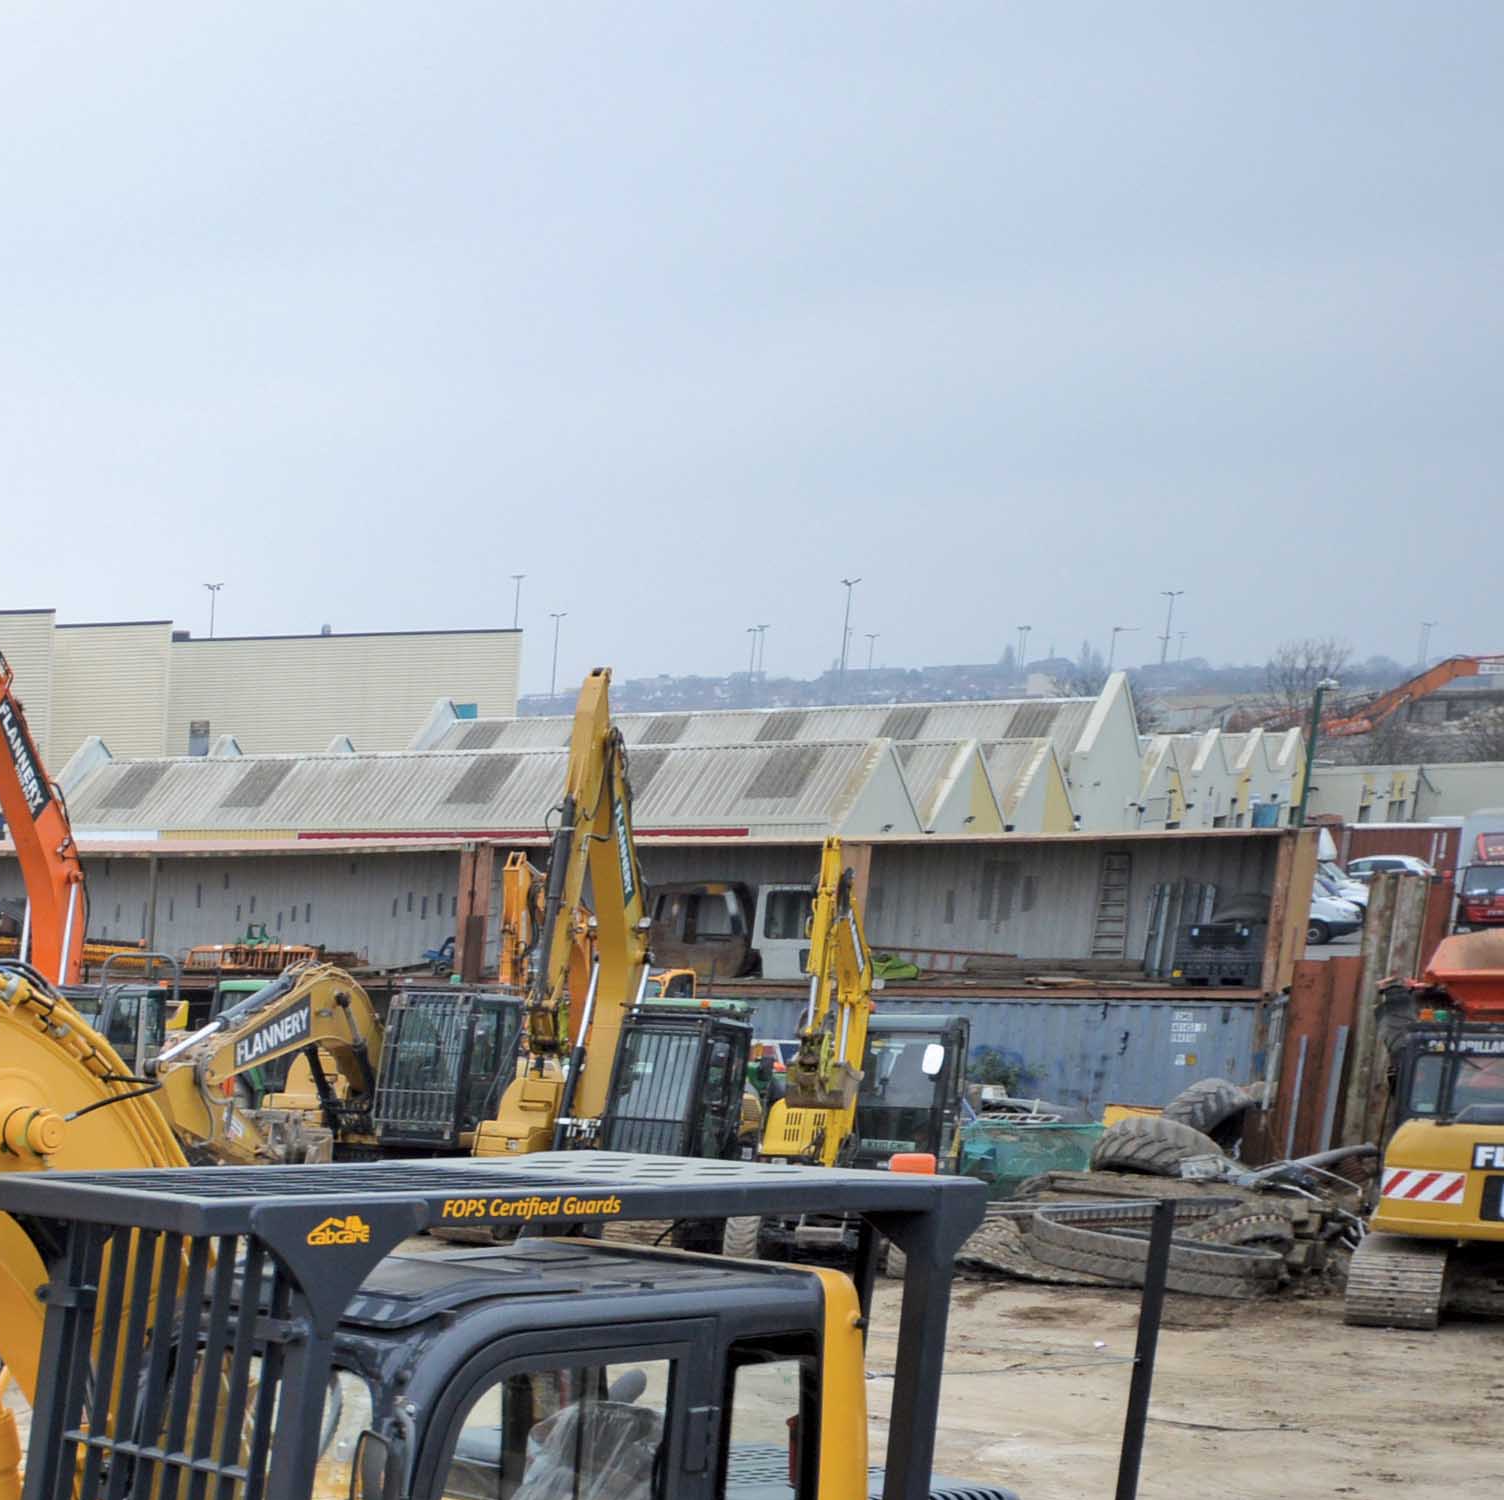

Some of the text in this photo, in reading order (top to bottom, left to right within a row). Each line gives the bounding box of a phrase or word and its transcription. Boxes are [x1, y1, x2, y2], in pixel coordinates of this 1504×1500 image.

[235, 1007, 310, 1066] FLANNERY
[442, 1194, 622, 1222] FOPS Certified Guards
